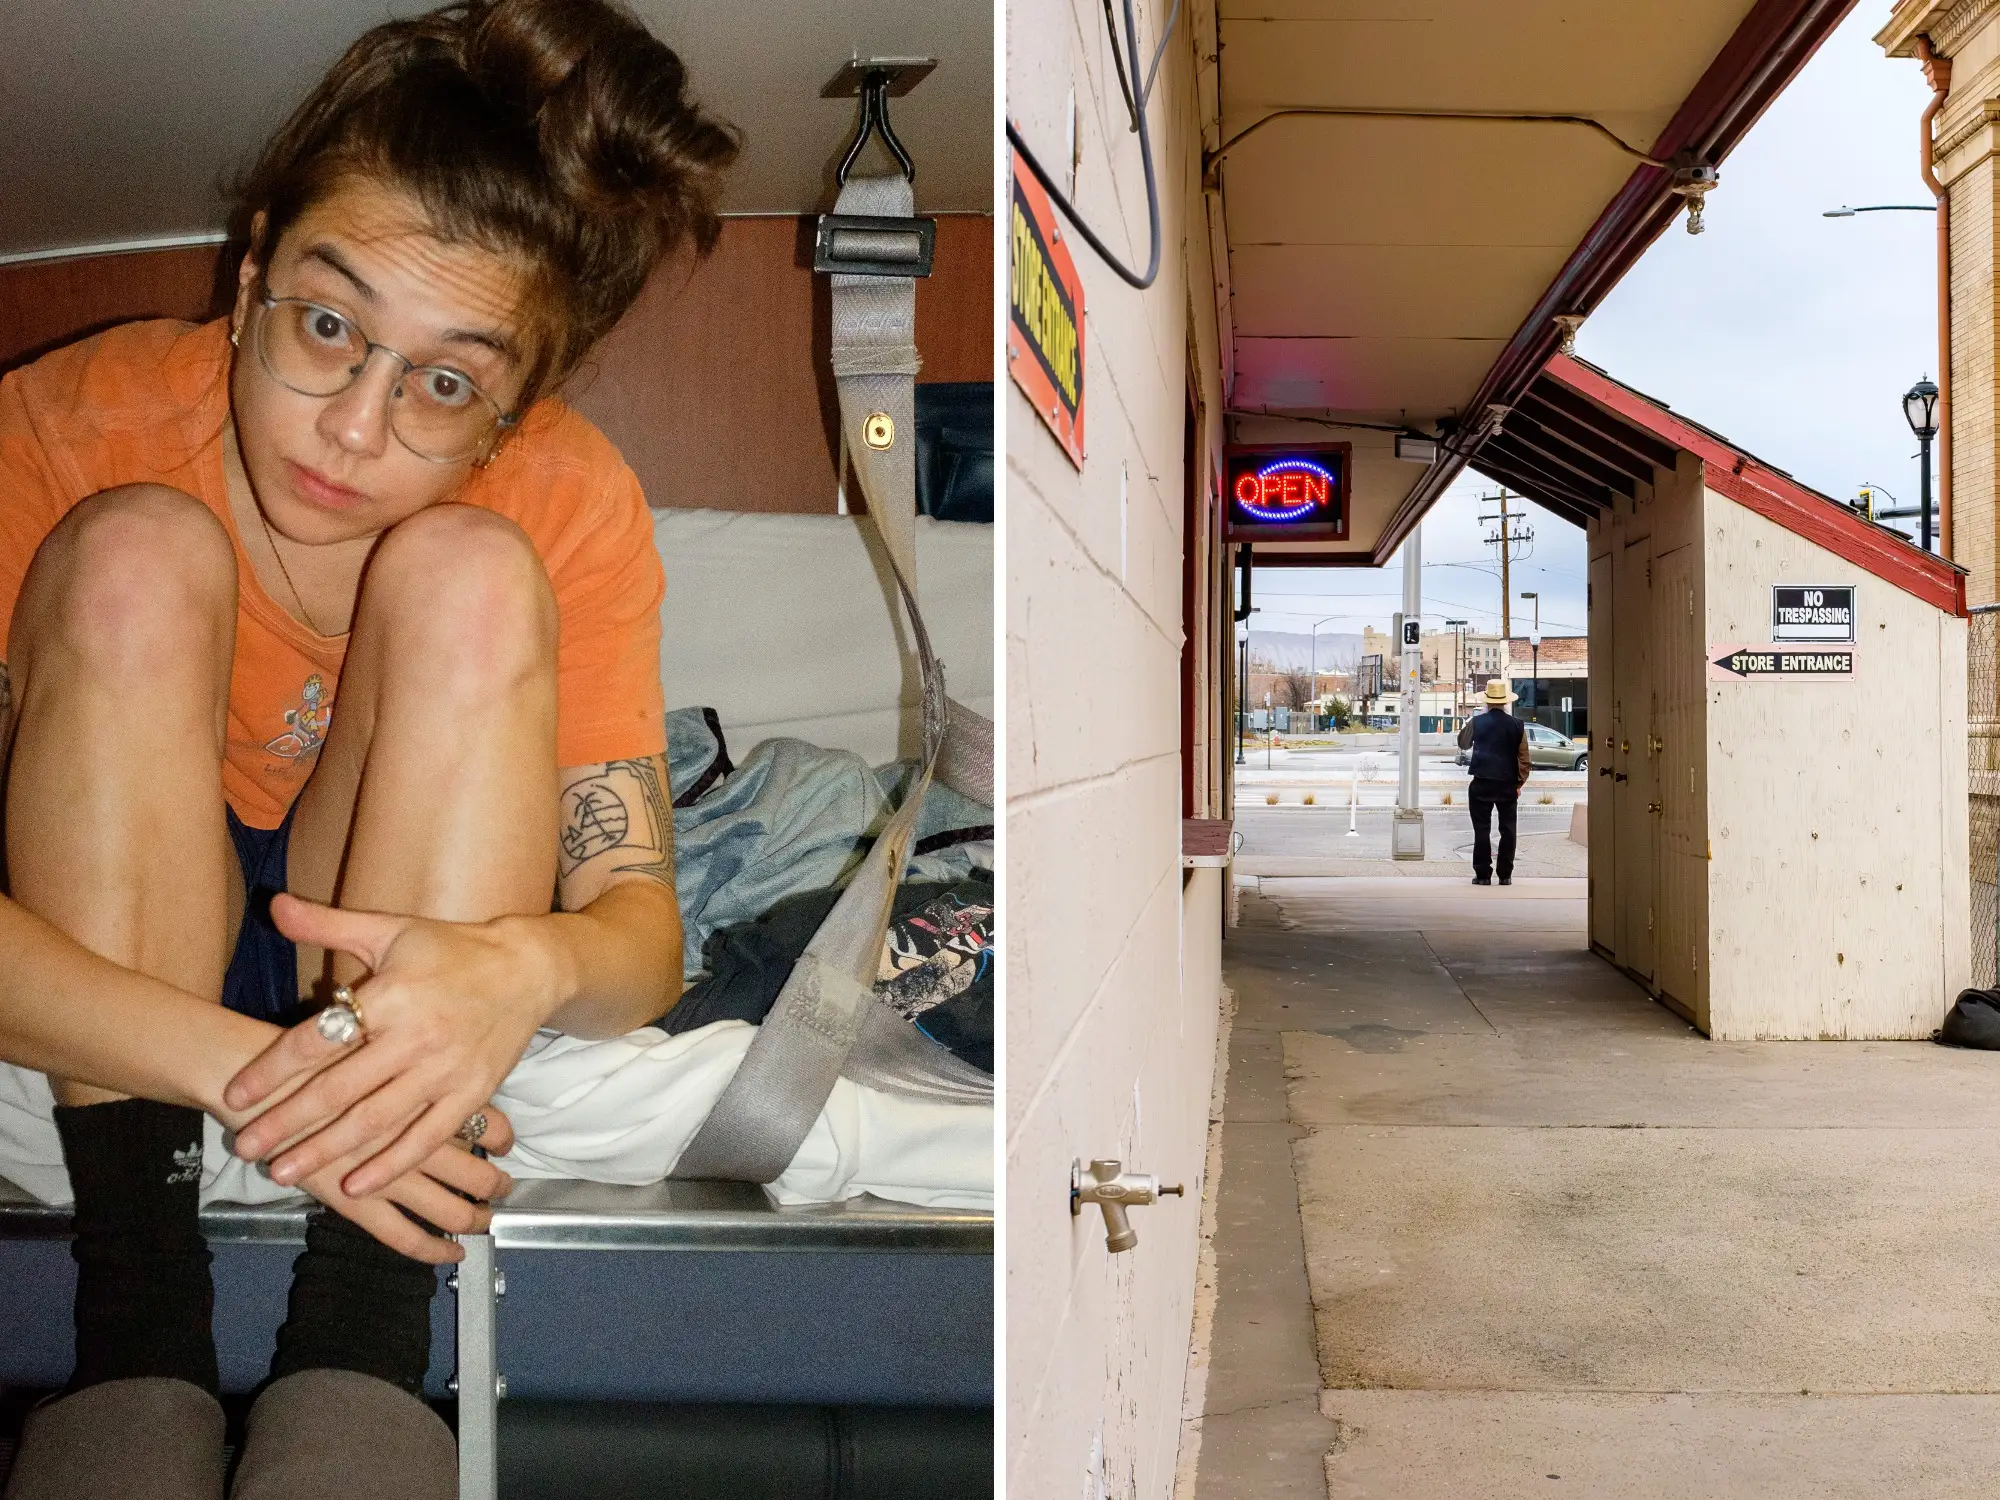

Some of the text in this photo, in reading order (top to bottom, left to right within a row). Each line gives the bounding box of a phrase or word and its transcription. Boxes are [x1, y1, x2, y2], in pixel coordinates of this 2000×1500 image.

[1012, 202, 1077, 407] STORE ENTRANCE
[1235, 473, 1328, 506] OPEN
[1803, 590, 1824, 607] NO
[1778, 607, 1850, 624] TRESPASSING
[1731, 655, 1851, 671] STORE ENTRANCE
